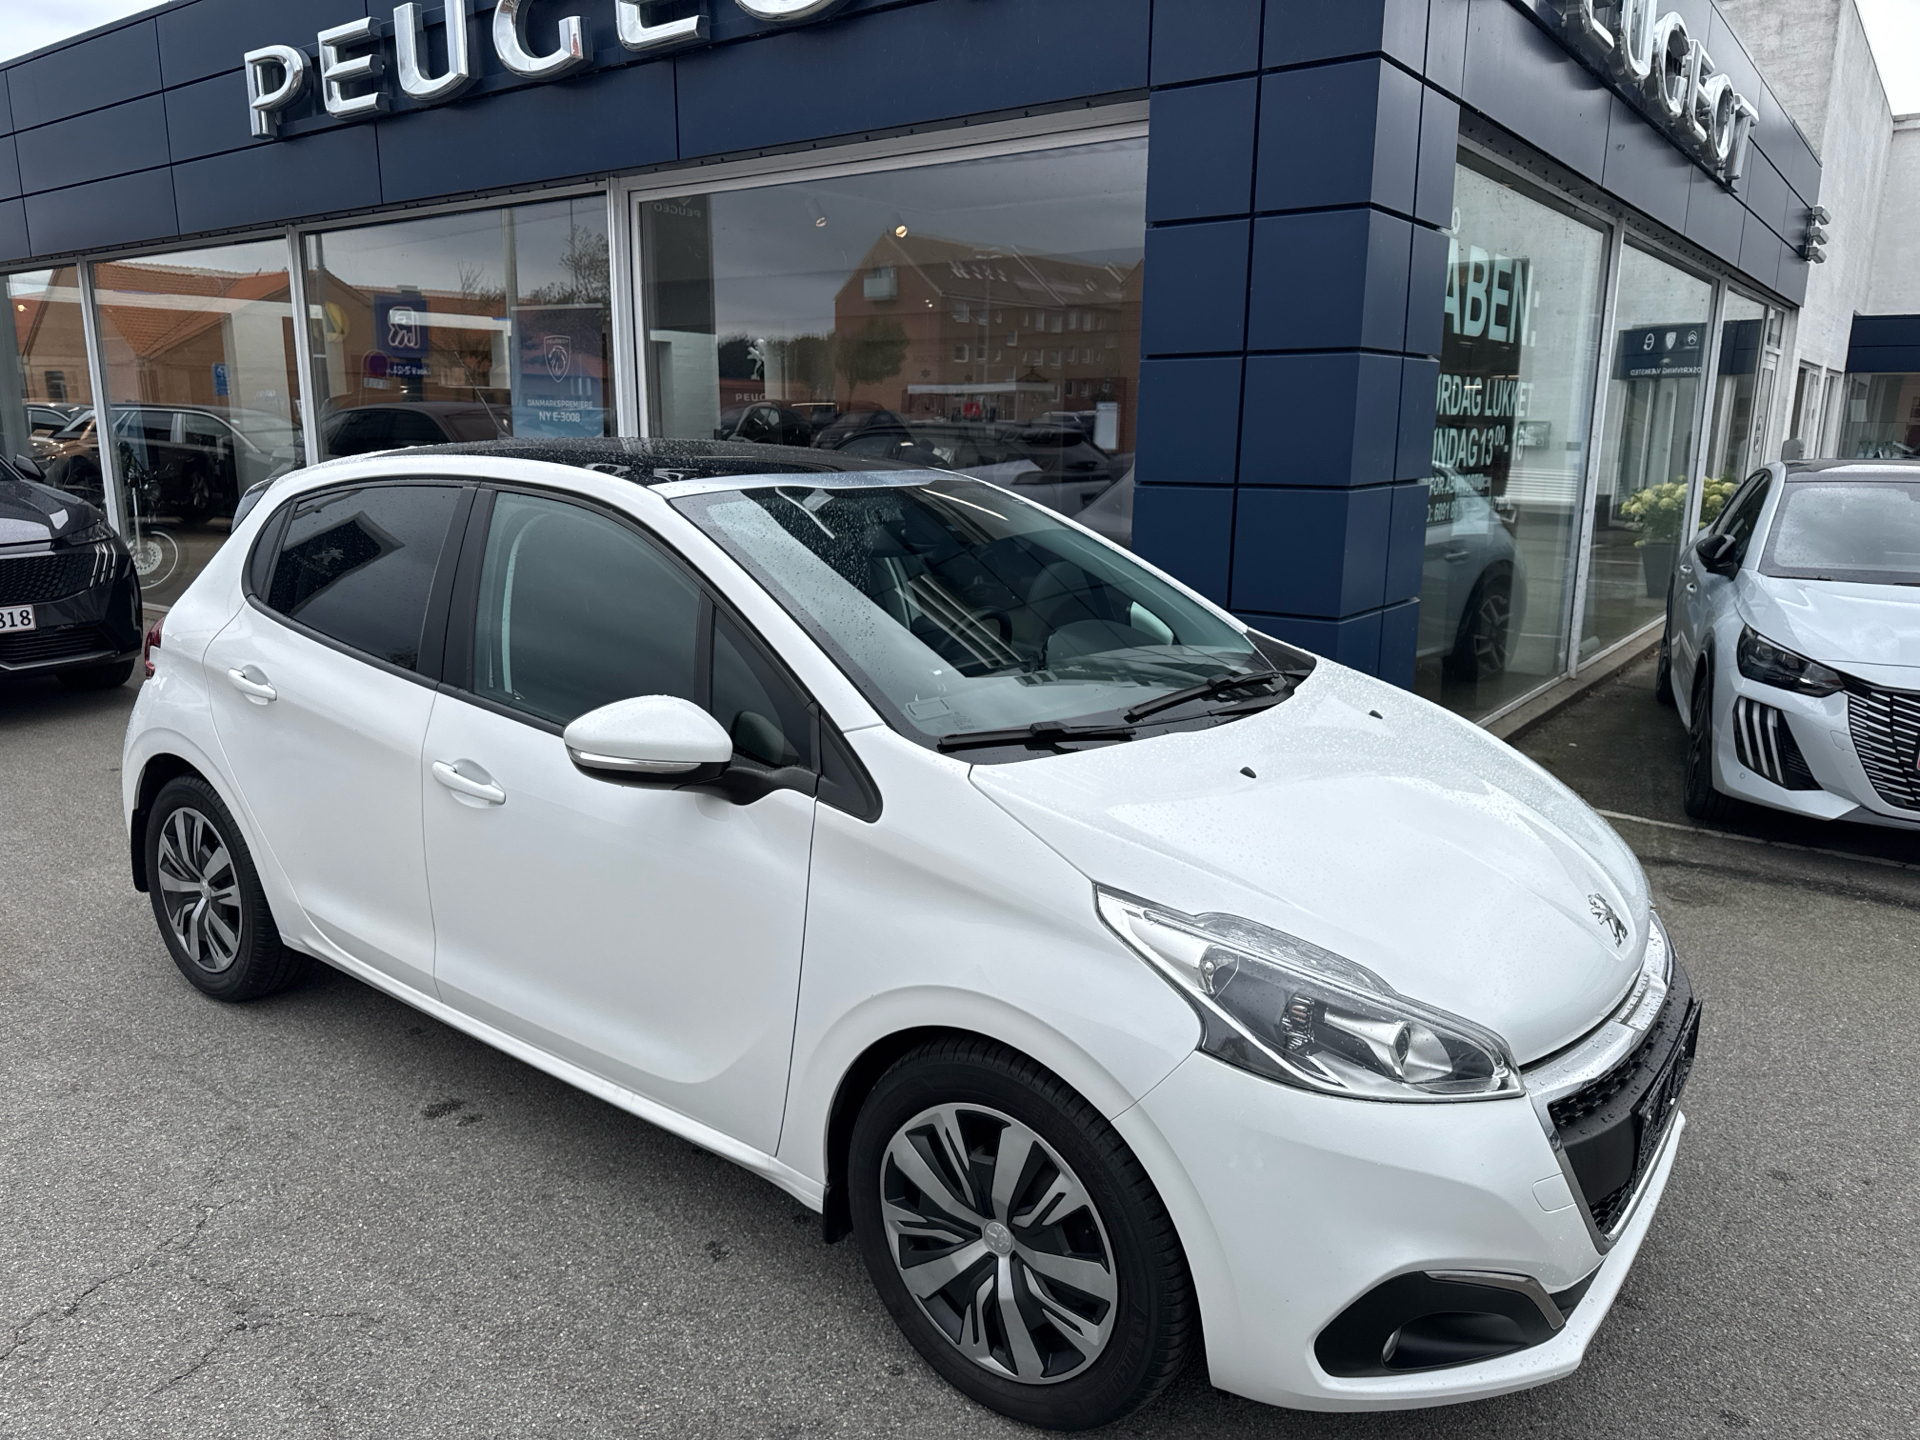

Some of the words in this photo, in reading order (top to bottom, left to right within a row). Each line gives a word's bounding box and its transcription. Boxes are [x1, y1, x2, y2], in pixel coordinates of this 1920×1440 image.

[244, 0, 840, 138] PEUG
[527, 398, 594, 409] DANMARKSPREMIERE
[1484, 378, 1535, 417] LUKKET
[538, 411, 552, 421] NY
[553, 411, 581, 423] E-3008
